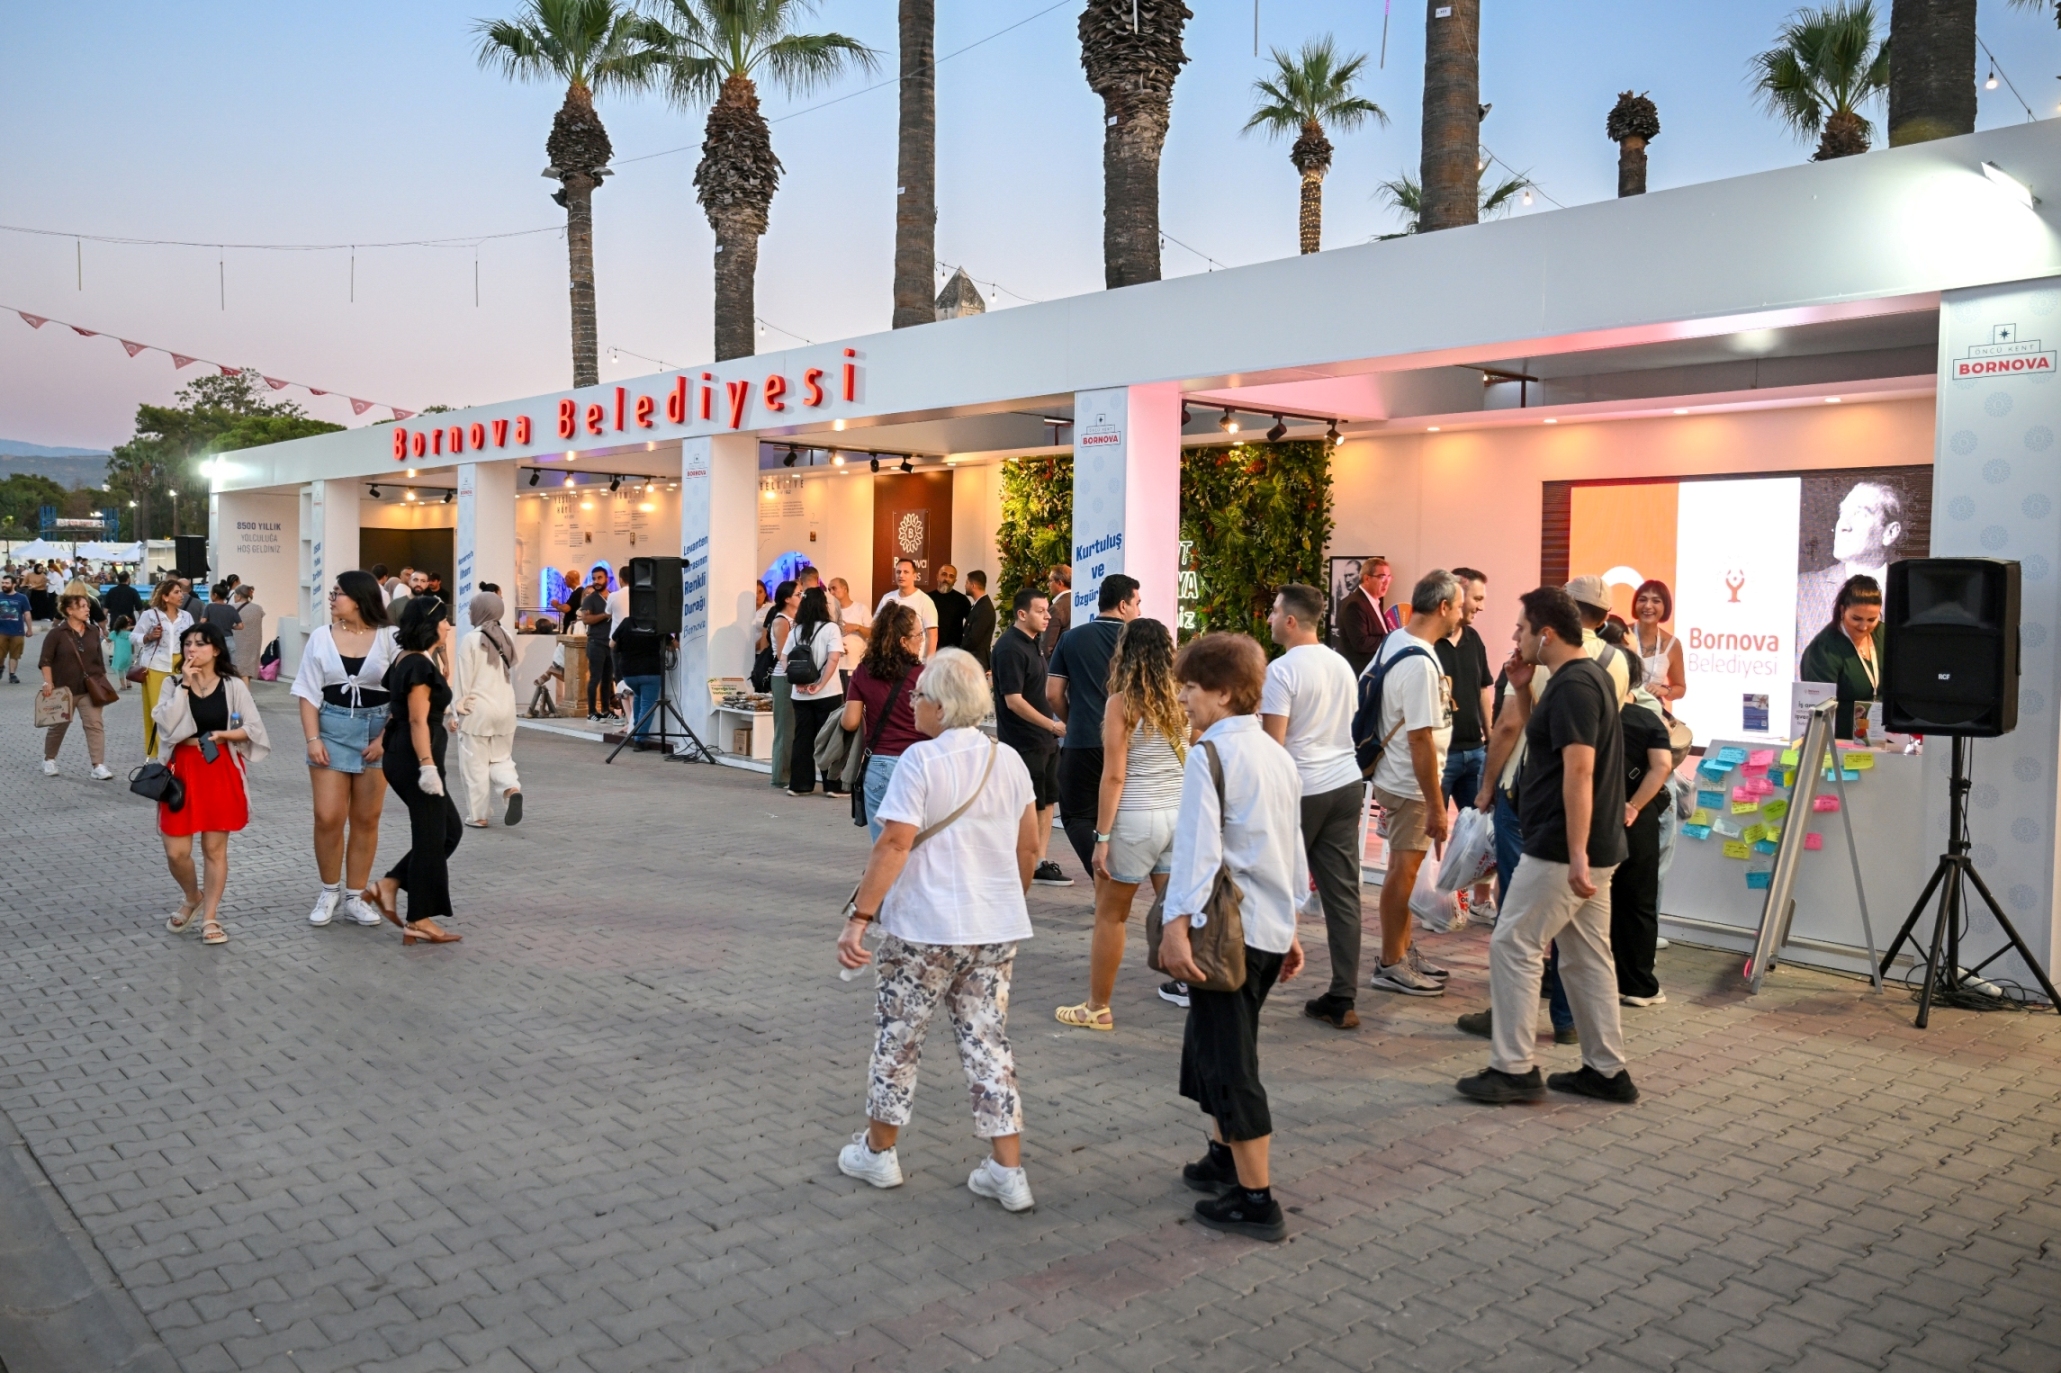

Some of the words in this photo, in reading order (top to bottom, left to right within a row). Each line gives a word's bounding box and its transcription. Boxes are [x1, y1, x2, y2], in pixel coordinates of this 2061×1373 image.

[1975, 346, 2003, 355] ÖNCÜ
[2008, 344, 2035, 352] KENT
[1959, 357, 2050, 375] BORNOVA
[393, 414, 531, 460] Bornova
[557, 348, 856, 439] Belediyesi
[1082, 434, 1119, 445] BORNOVA
[237, 521, 256, 530] 8500
[258, 522, 281, 531] YILLIK
[241, 533, 278, 542] YOLCULUĞA
[237, 544, 251, 554] HOŞ
[1076, 533, 1122, 562] Kurtuluş
[1091, 563, 1105, 579] ve
[684, 571, 706, 596] Renkli
[684, 595, 706, 617] Durağı
[1689, 627, 1779, 652] Bornova
[1688, 653, 1778, 679] Belediyesi
